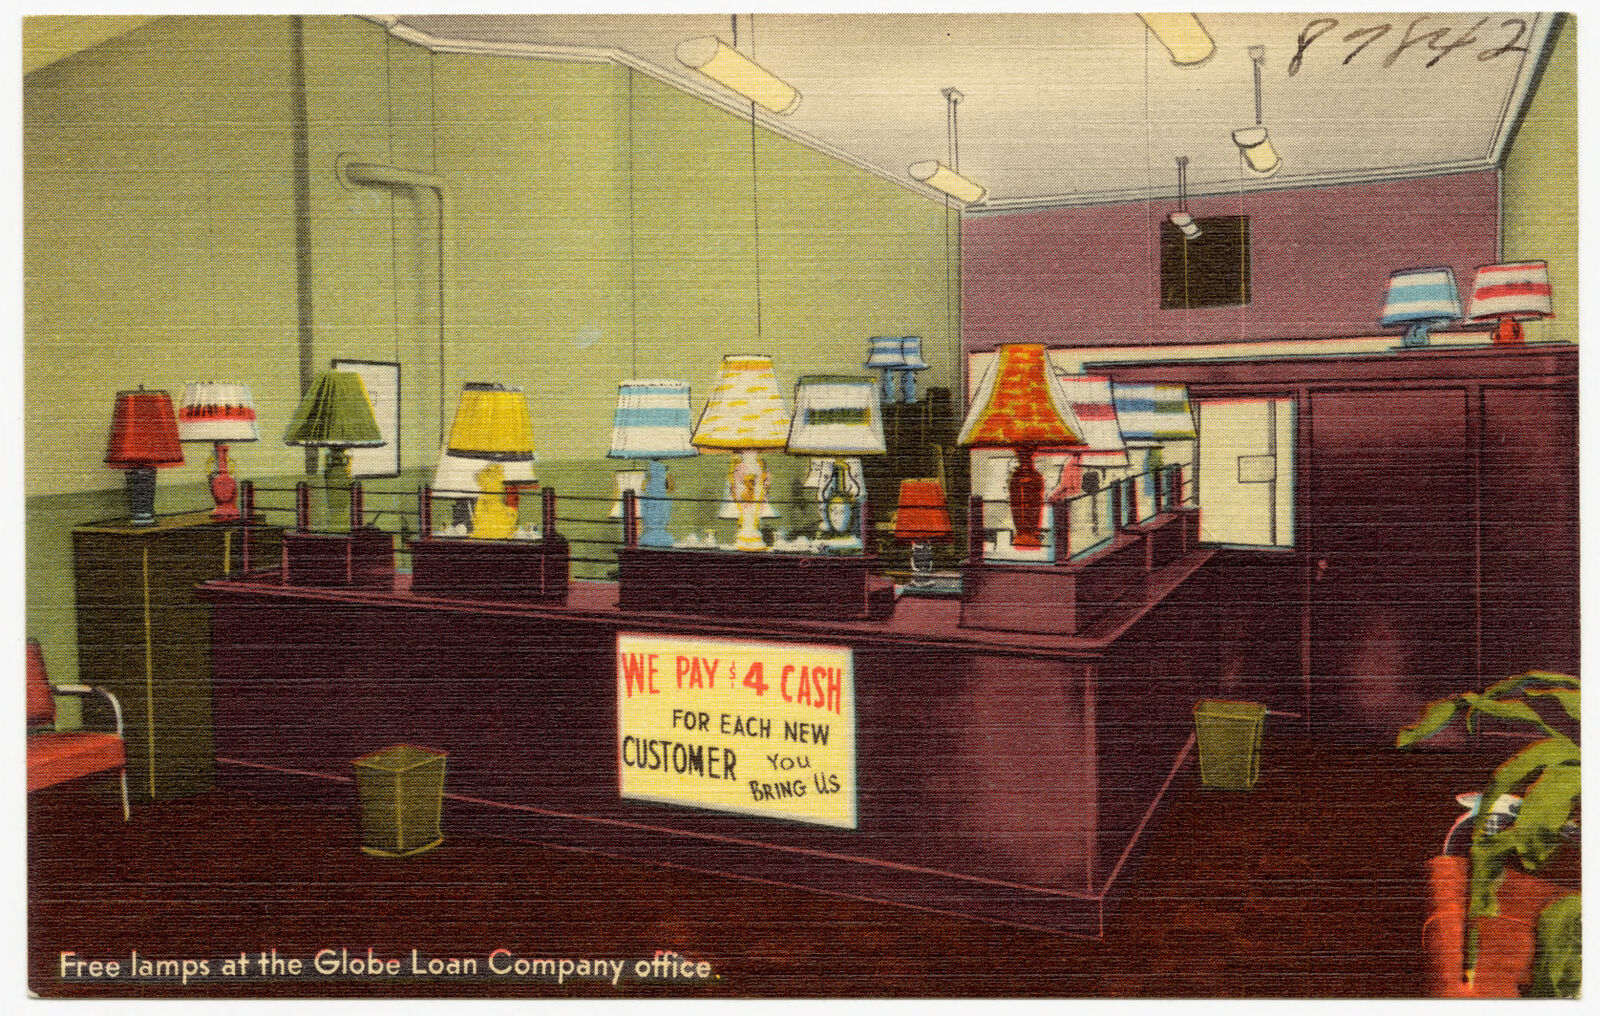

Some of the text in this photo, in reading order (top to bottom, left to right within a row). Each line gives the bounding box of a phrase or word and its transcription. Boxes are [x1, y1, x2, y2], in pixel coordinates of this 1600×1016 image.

[622, 652, 660, 698] WE
[676, 655, 719, 689] PAY
[781, 664, 842, 715] CASH
[672, 709, 830, 746] FOR EACH NEW
[623, 735, 737, 781] CUSTOMER
